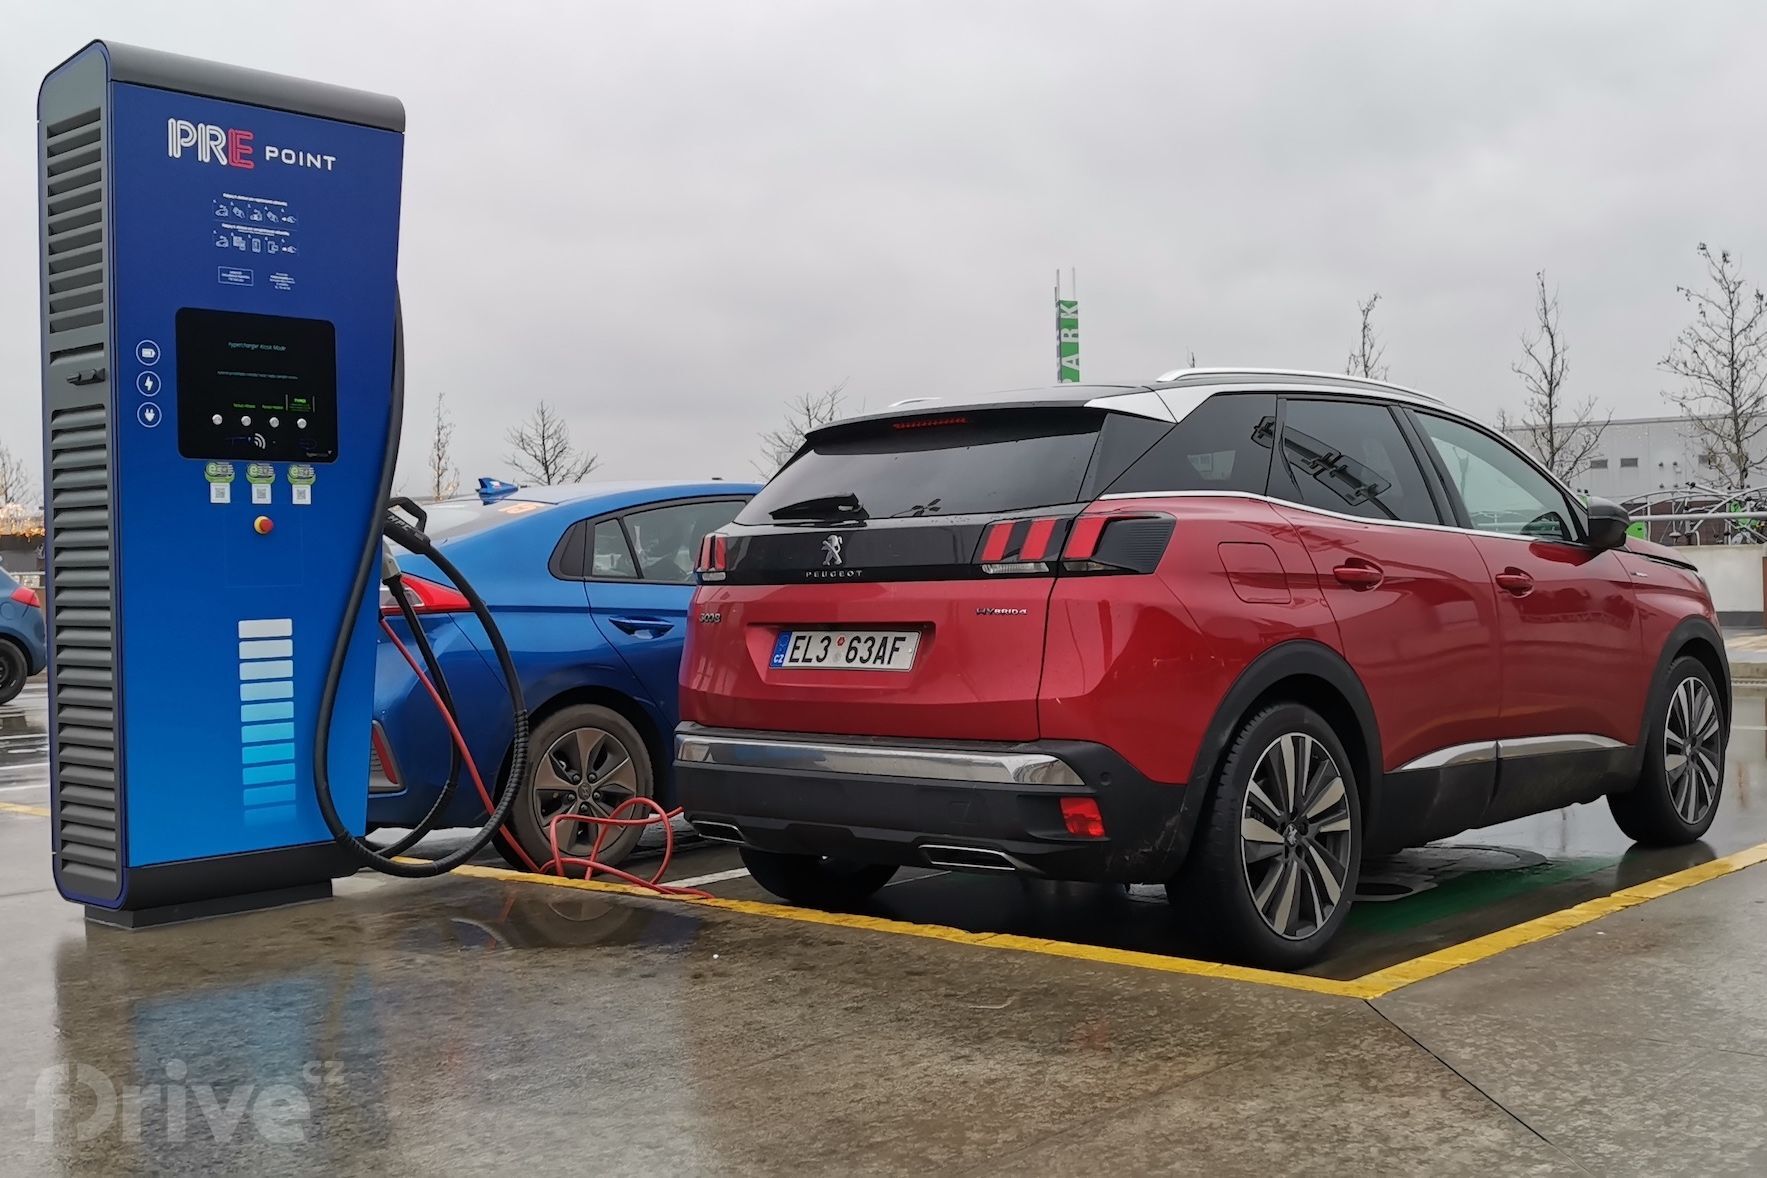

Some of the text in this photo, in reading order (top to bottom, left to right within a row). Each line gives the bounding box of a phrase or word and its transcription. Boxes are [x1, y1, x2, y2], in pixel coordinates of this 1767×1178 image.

[168, 118, 337, 171] PRE POINT
[805, 569, 863, 578] PEUGEOT
[773, 635, 907, 665] CZ EL3 63AF
